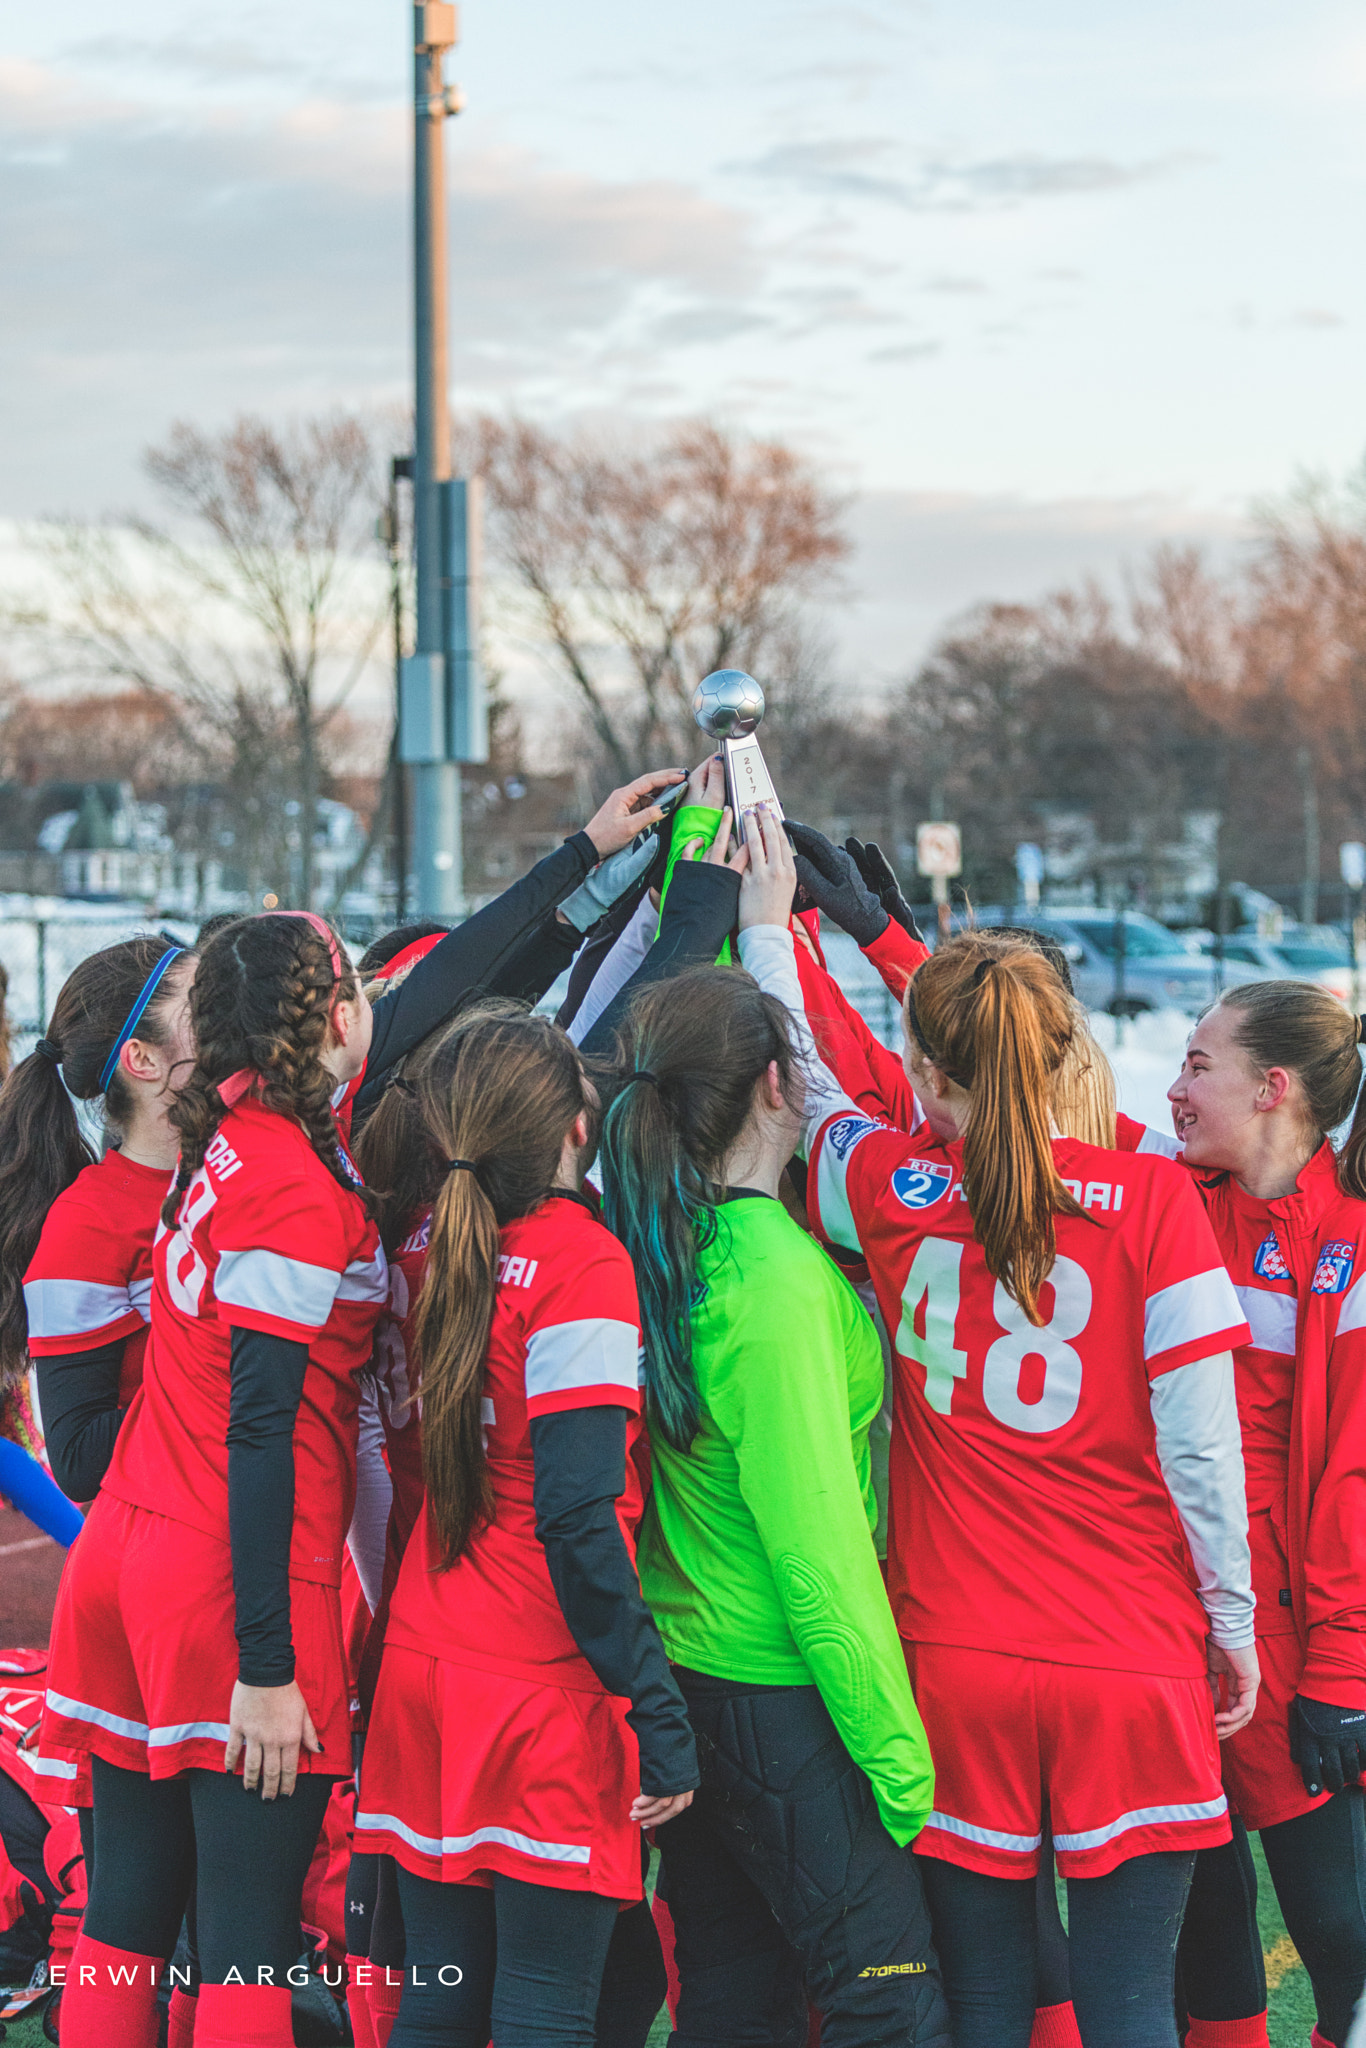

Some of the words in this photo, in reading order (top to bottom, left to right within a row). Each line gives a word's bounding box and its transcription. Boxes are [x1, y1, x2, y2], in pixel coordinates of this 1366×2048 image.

[744, 757, 756, 793] 2017
[909, 1160, 939, 1175] RTE
[902, 1173, 932, 1205] 2
[895, 1236, 1093, 1434] 48
[1340, 1714, 1366, 1725] HEAD
[857, 1962, 927, 1978] STORELLI
